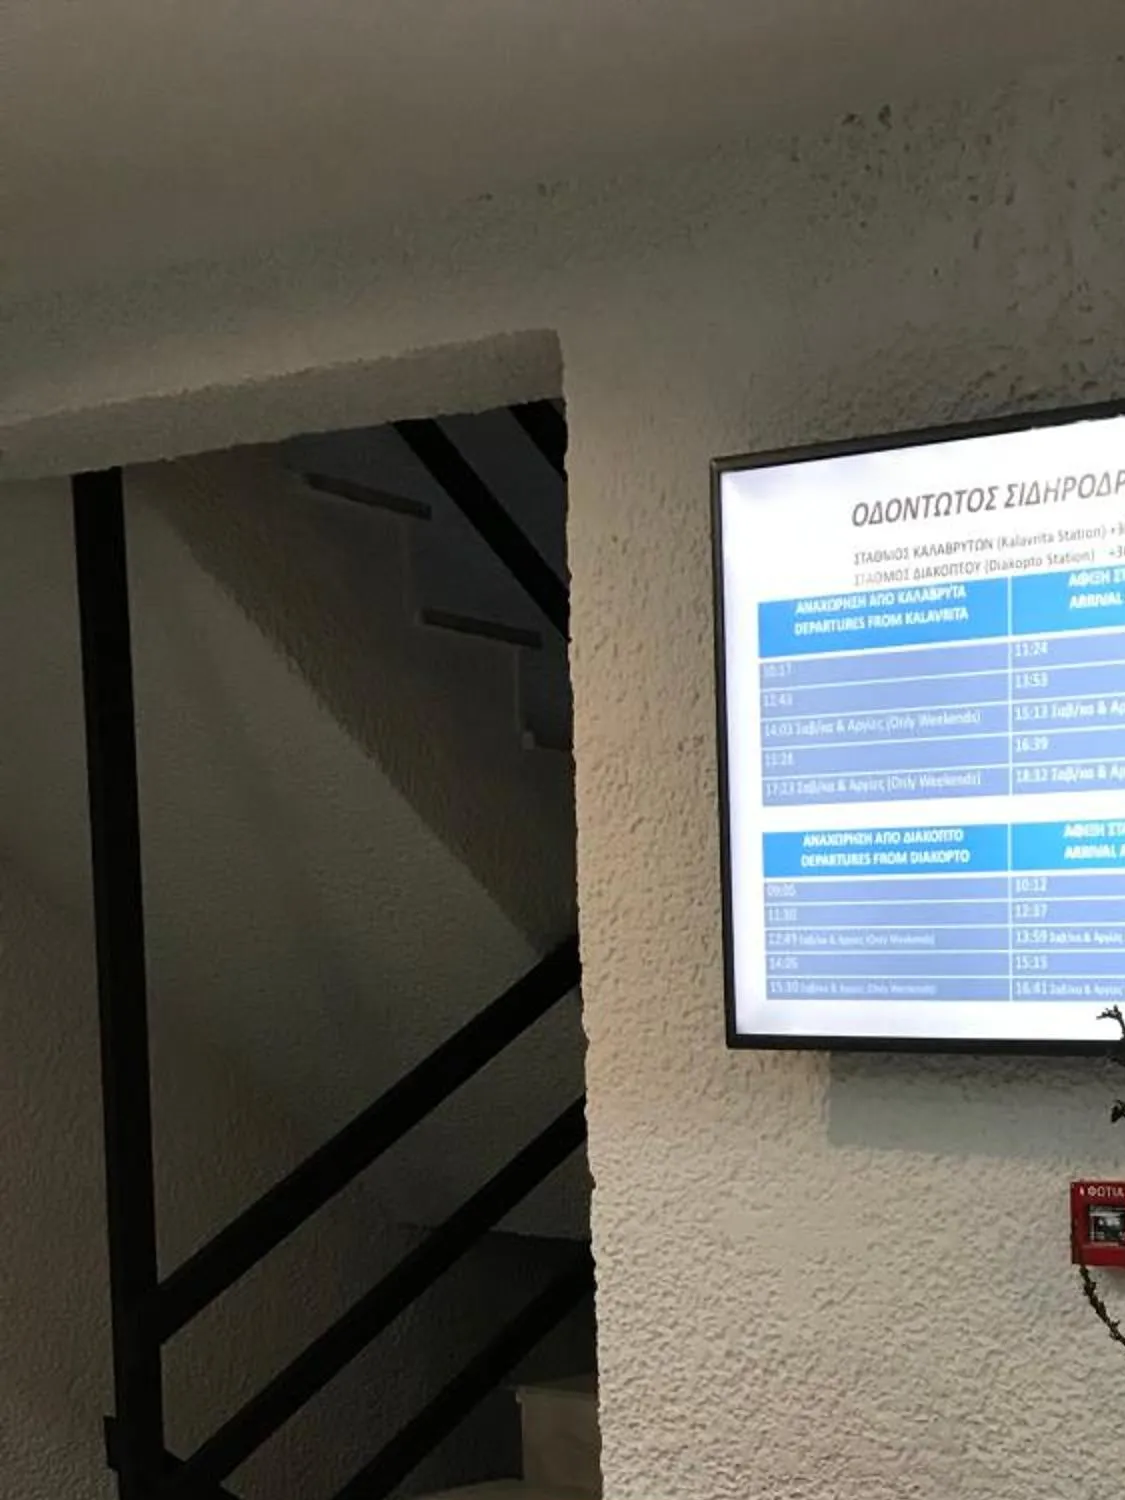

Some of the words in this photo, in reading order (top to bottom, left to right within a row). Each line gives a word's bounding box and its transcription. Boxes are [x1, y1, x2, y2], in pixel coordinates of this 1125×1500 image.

[851, 485, 1000, 528] ΟΔΟΝΤΩΤΟΣ
[913, 538, 994, 559] ΚΑΛΑΒΡΥΤΩΝ
[1057, 523, 1108, 545] Station)
[985, 553, 1043, 576] (Diakopto
[1046, 548, 1096, 568] Station)
[794, 615, 866, 636] DEPARTURES
[867, 612, 903, 629] FROM
[904, 606, 969, 625] KALAVRITA
[873, 851, 908, 865] FROM
[909, 848, 971, 864] DIAKOPTO
